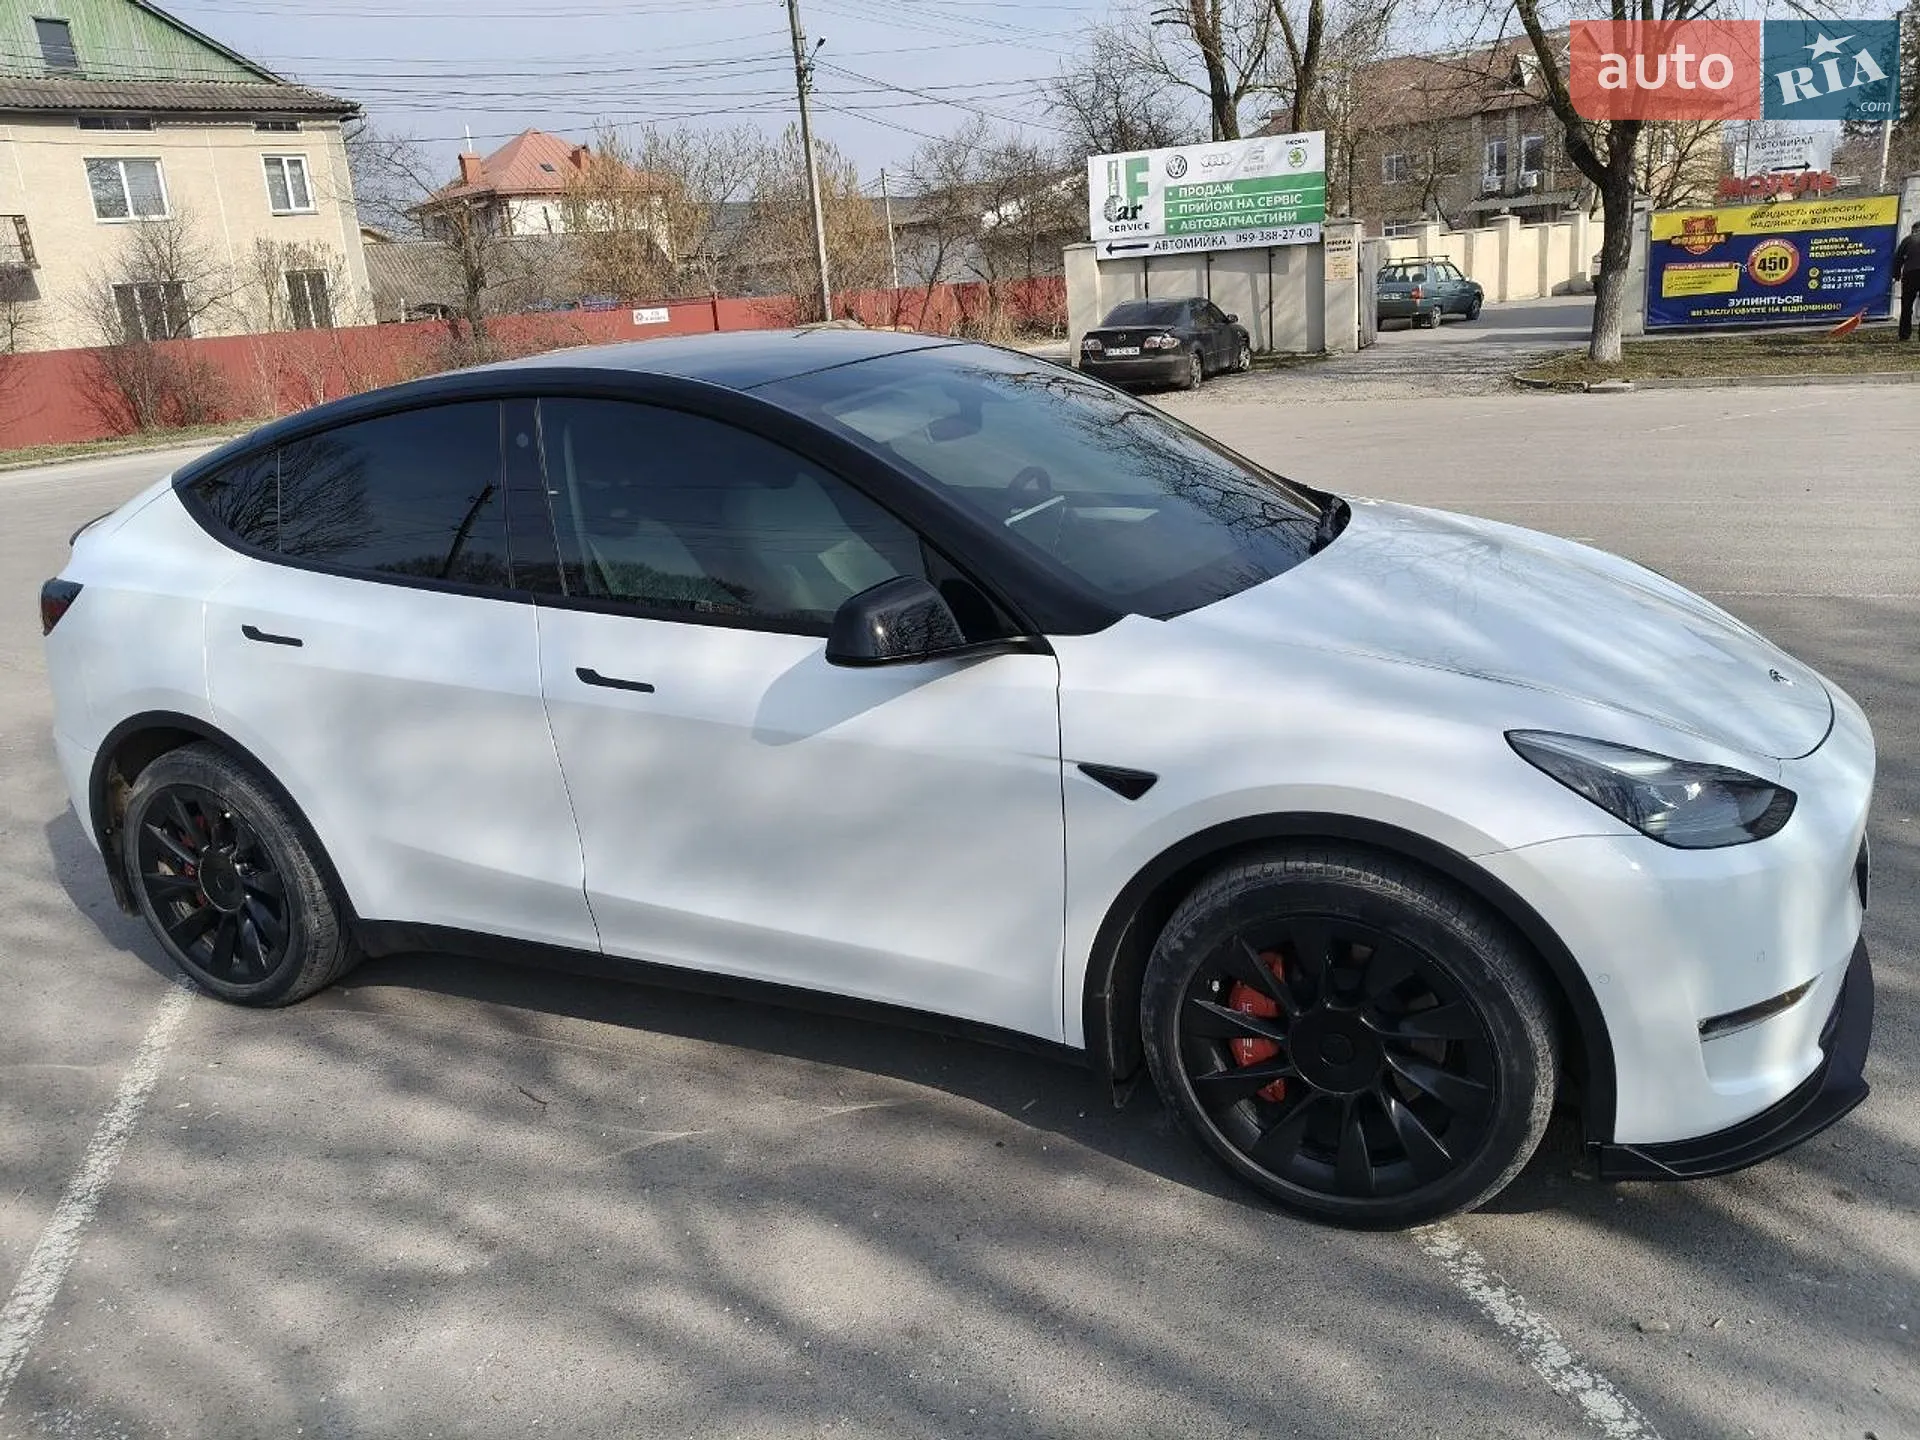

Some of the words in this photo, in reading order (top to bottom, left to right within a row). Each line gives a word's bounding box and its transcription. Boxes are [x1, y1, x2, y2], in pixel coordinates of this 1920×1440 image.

[1178, 182, 1234, 199] ПРОДАЖ
[1179, 199, 1233, 215] ПРИЙОМ
[1237, 197, 1255, 210] НА
[1257, 193, 1303, 207] СЕРВІС
[1108, 222, 1150, 234] SERVICE
[1179, 211, 1298, 231] АВТОЗАПЧАСТИНИ
[1153, 235, 1228, 251] АВТОМИЙКА
[1757, 256, 1789, 271] 450
[1728, 295, 1803, 307] ЗУПИНІТЬСЯ!
